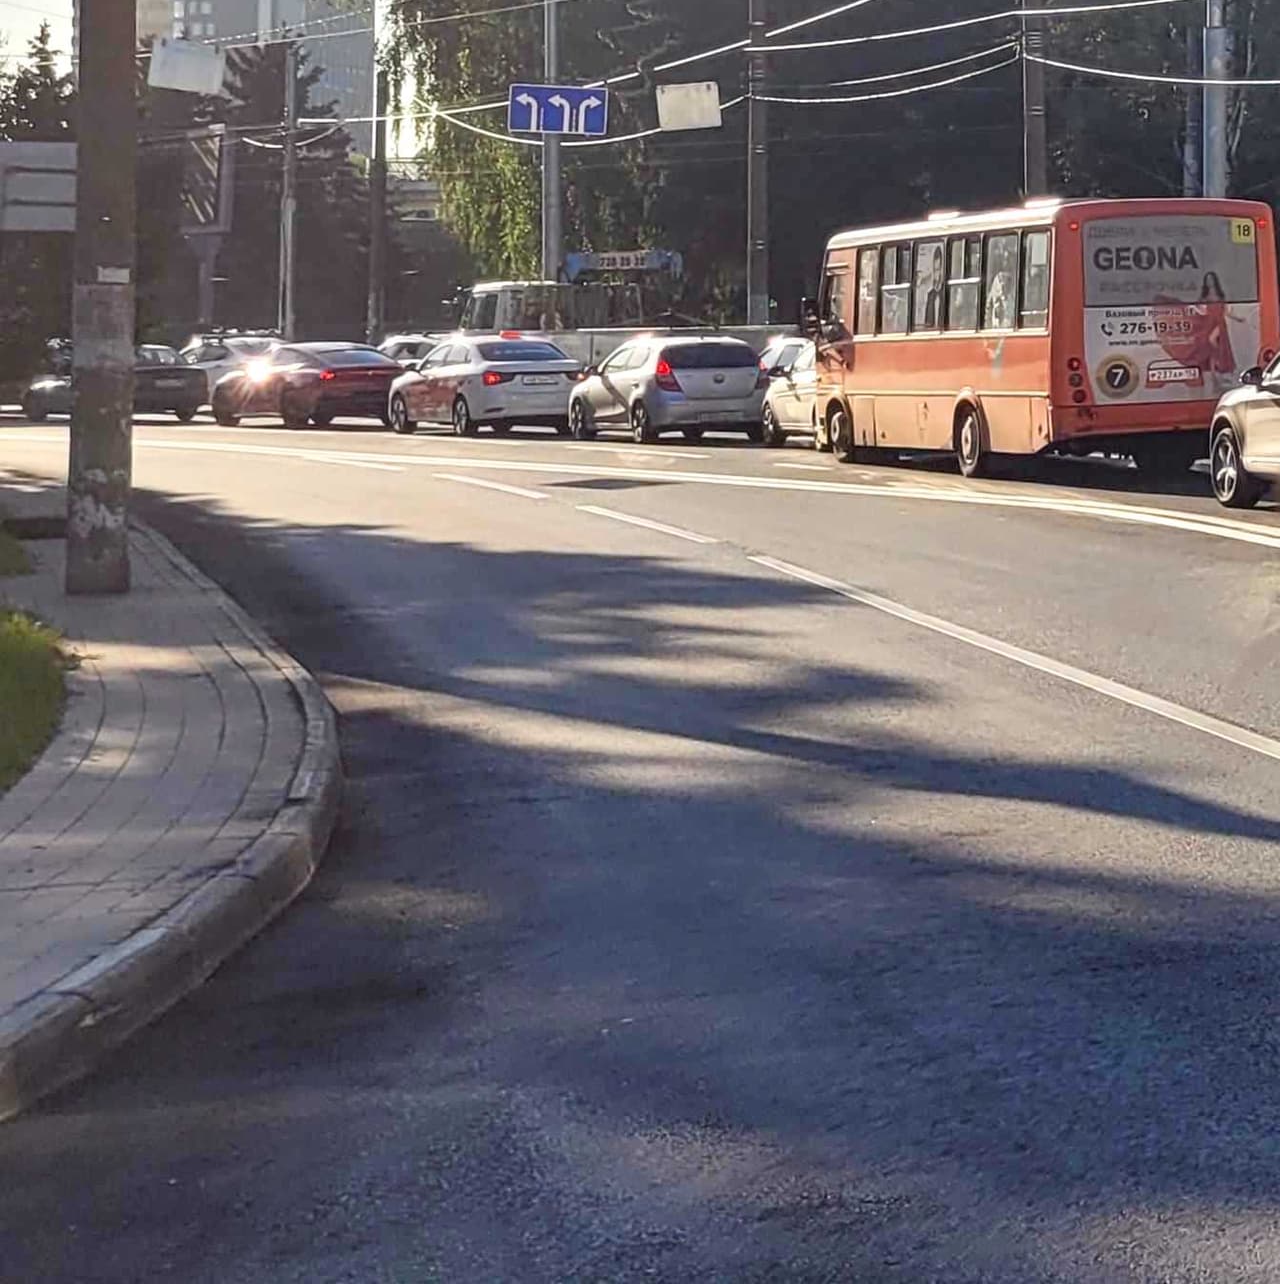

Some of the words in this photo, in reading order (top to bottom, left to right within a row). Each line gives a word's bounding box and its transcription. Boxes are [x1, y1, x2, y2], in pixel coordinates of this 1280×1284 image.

[1236, 224, 1250, 237] 18
[1093, 246, 1199, 270] GEONA
[1119, 321, 1191, 334] 276-19-39
[1111, 368, 1125, 387] 7
